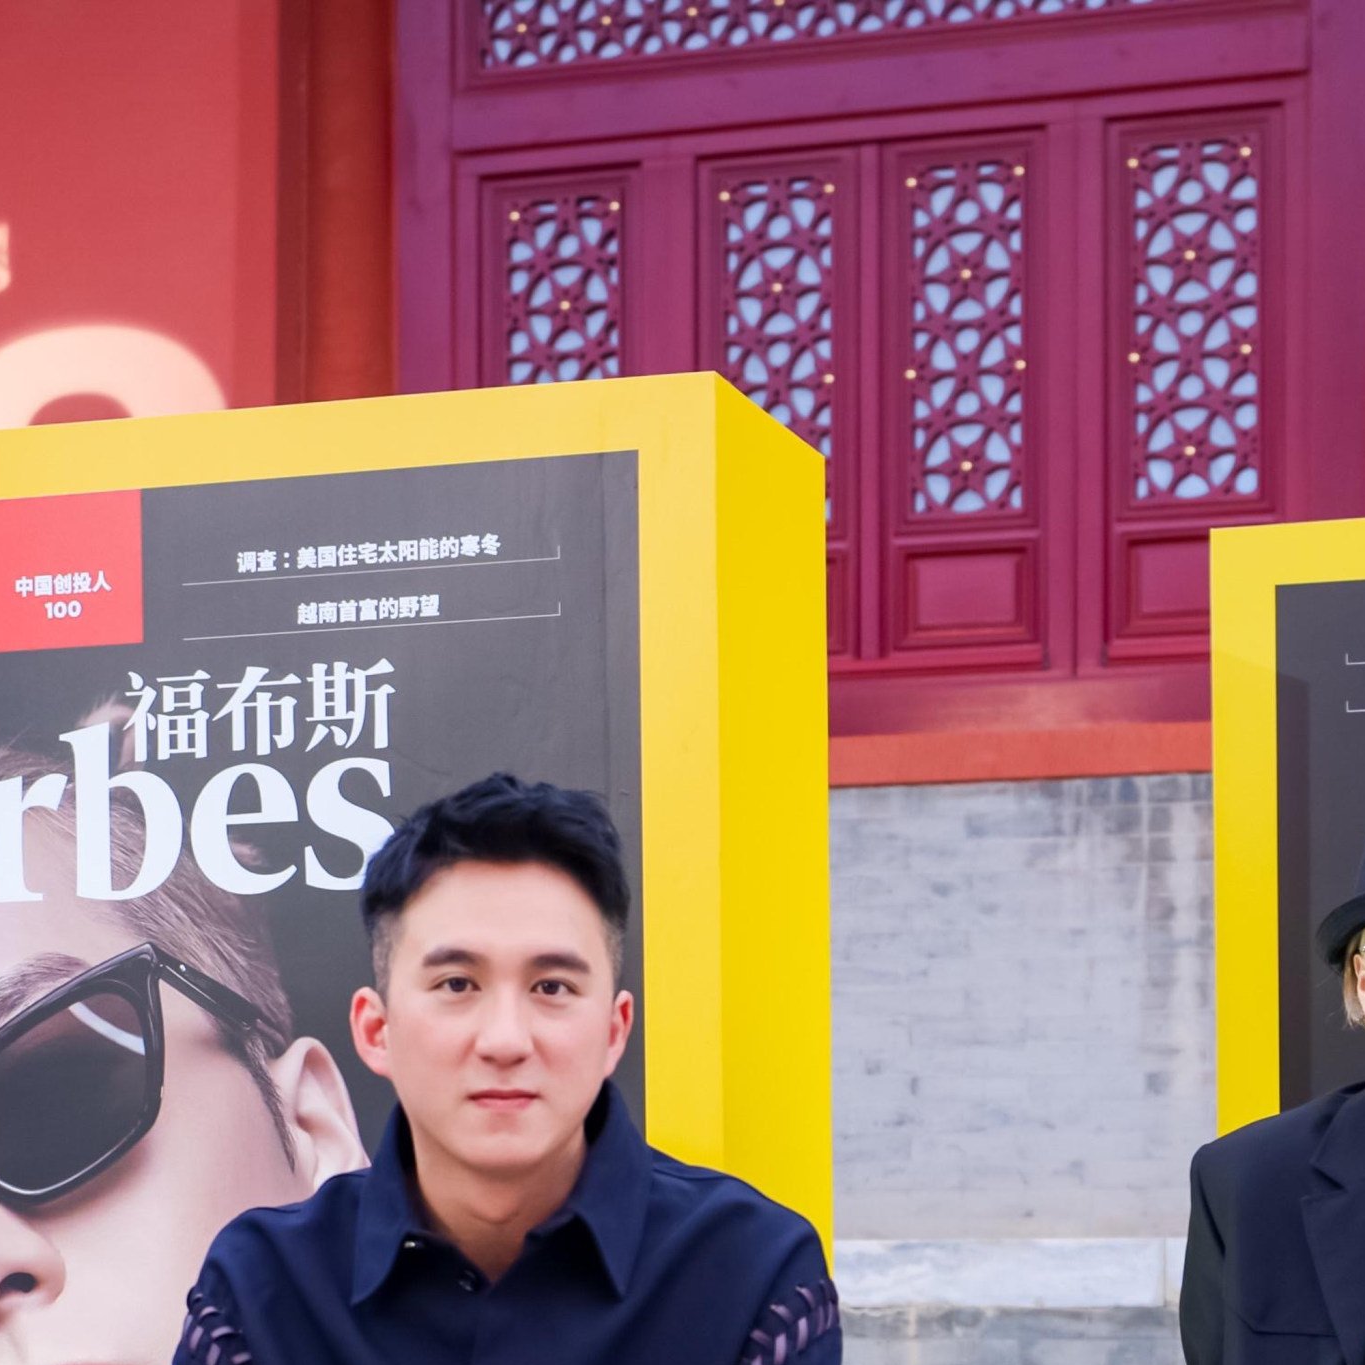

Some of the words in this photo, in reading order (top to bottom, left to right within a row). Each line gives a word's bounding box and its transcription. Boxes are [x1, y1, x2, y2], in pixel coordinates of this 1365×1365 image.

[236, 533, 501, 573] 调查：美国住宅太阳能的寒冬
[15, 570, 112, 598] 中国创投人
[44, 599, 83, 619] 100
[297, 594, 440, 625] 越南首富的野望
[122, 658, 397, 762] 福布斯
